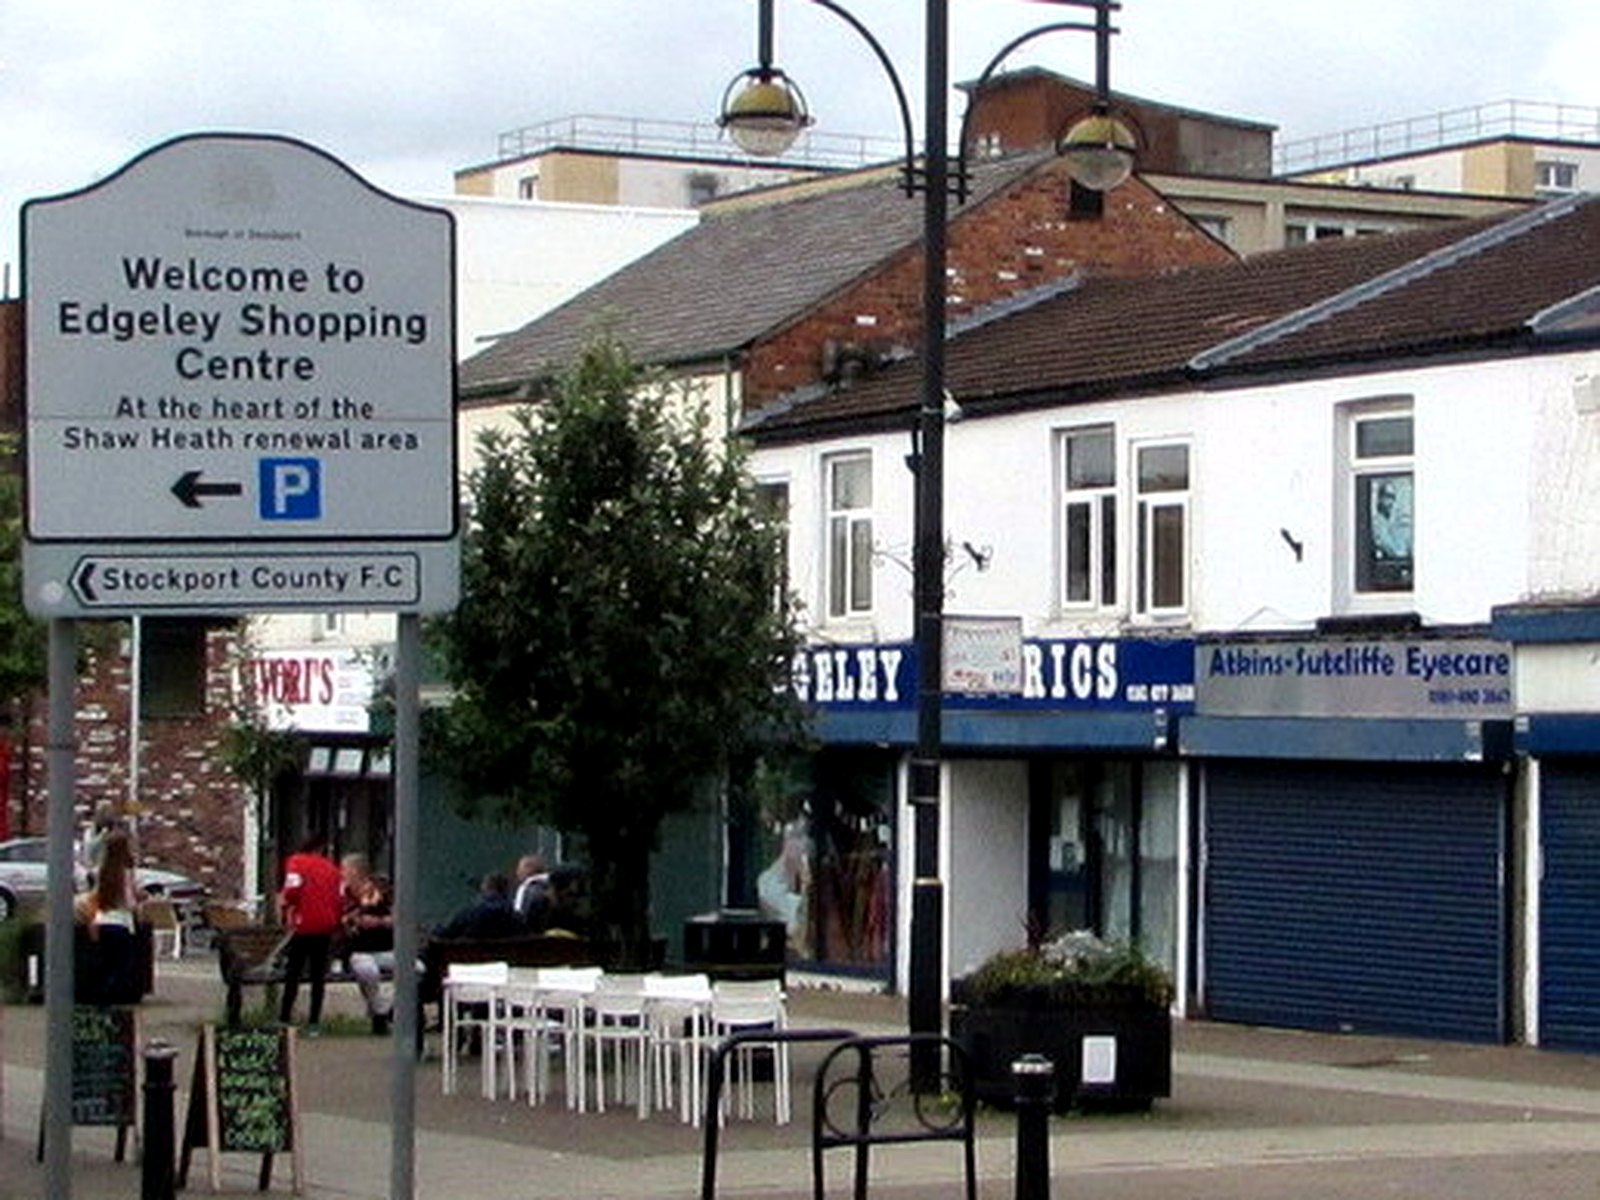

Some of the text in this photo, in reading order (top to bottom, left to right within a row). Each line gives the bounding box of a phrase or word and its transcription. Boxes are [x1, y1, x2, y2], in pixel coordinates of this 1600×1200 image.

[122, 257, 364, 293] Welcome to
[59, 302, 427, 345] Edgeley Shopping
[176, 347, 315, 380] Centre
[116, 397, 374, 420] At the heart of the
[63, 426, 419, 450] Shaw Heath renewal area
[274, 464, 311, 515] P
[102, 567, 240, 593] Stockport
[251, 566, 349, 593] County
[246, 657, 335, 706] VORI'S
[773, 649, 902, 703] GELEY
[1022, 642, 1119, 701] RICS
[1405, 647, 1510, 682] Eyecare
